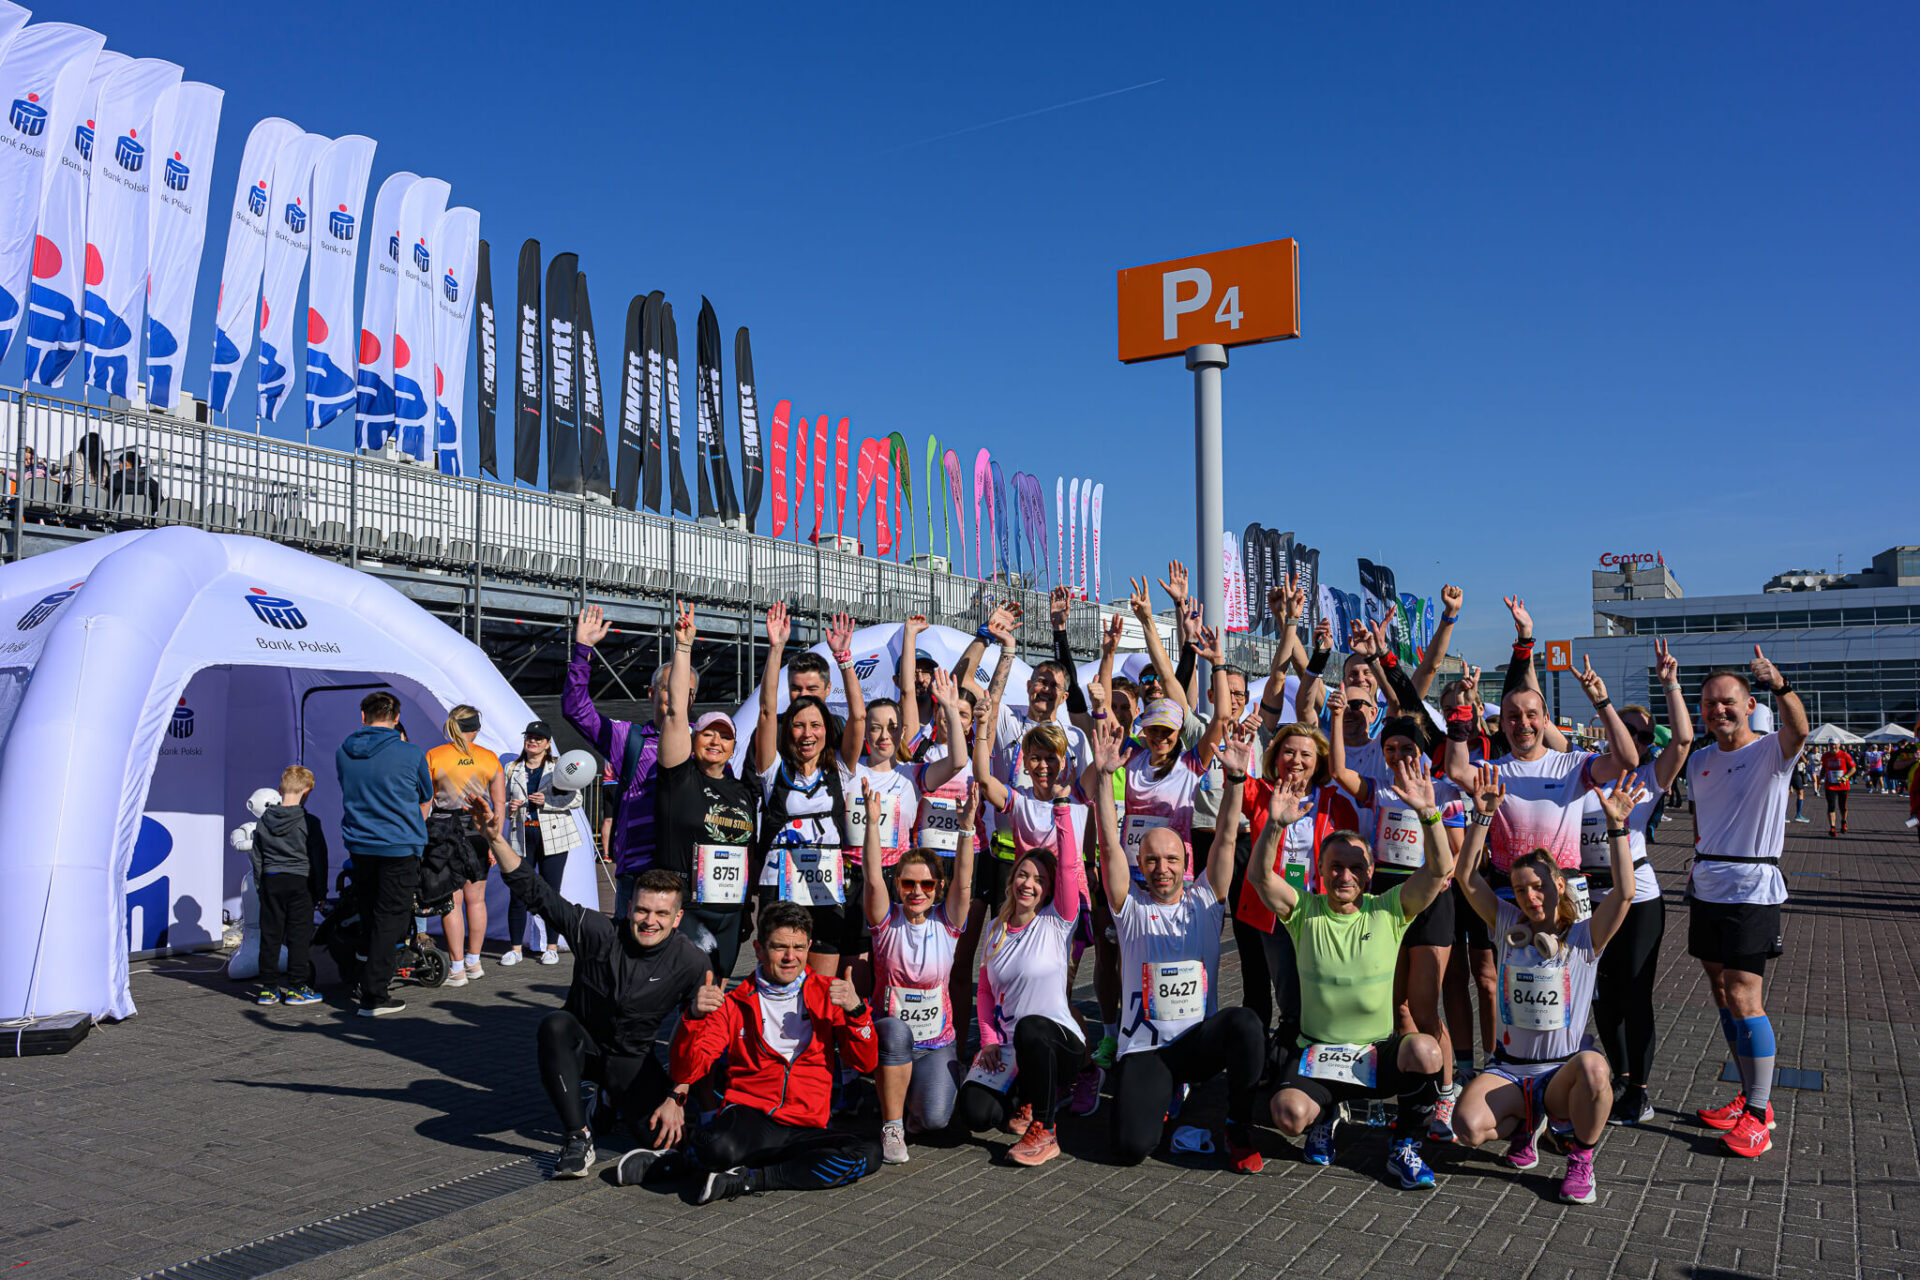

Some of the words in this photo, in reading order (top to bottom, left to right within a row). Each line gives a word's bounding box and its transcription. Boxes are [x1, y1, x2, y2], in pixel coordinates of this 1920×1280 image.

[0, 134, 17, 149] ank
[245, 595, 308, 630] PKO
[256, 637, 296, 651] Bank
[298, 640, 341, 653] Polski
[457, 758, 474, 766] AGA
[1127, 833, 1141, 846] 84
[1384, 826, 1417, 844] 8675
[1581, 832, 1609, 846] 844
[713, 866, 739, 880] 8751
[797, 869, 832, 883] 7808
[1159, 980, 1197, 998] 8427
[1513, 989, 1559, 1006] 8442
[900, 1006, 938, 1022] 8439
[1318, 1052, 1364, 1064] 8454
